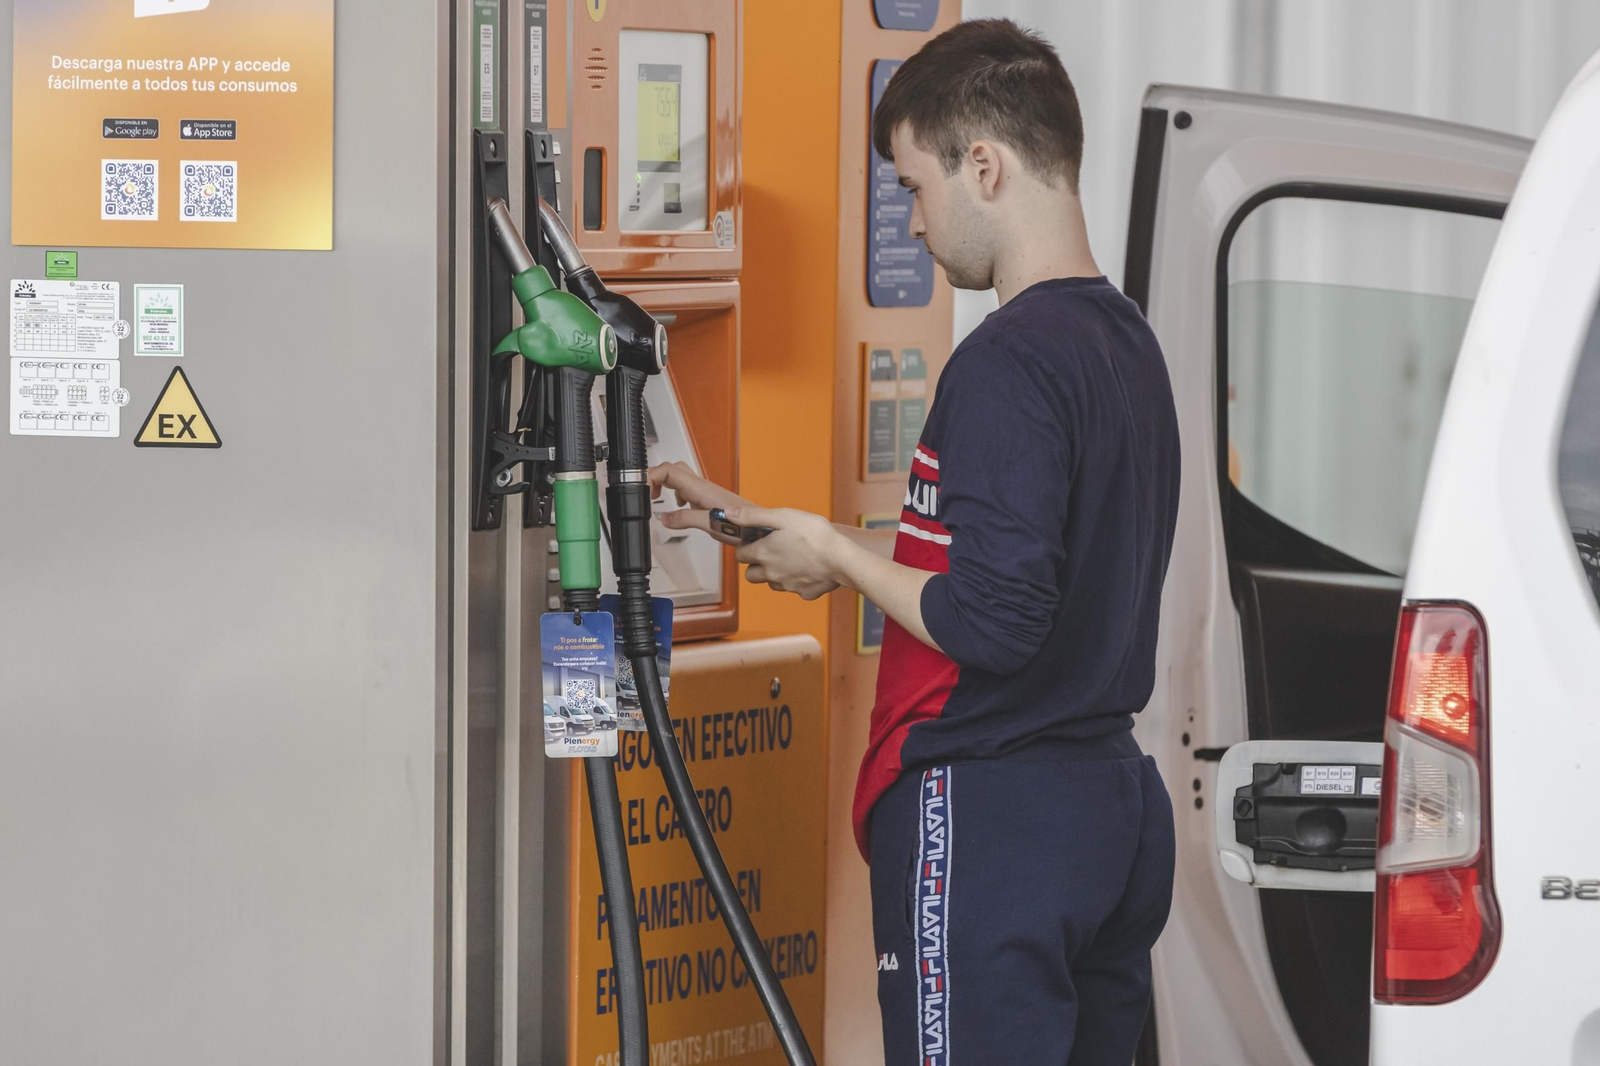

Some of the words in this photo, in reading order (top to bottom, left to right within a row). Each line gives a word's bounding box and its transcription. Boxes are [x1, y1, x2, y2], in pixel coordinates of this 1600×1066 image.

[51, 55, 122, 73] Descarga
[126, 58, 184, 71] nuestra
[187, 57, 218, 71] APP
[222, 60, 231, 74] y
[234, 57, 291, 72] accede
[47, 75, 128, 90] fácilmente
[132, 79, 140, 90] a
[145, 76, 188, 91] todos
[191, 78, 215, 91] tus
[219, 80, 298, 92] consumos
[115, 126, 141, 137] Google
[142, 127, 157, 137] play
[194, 128, 211, 138] App
[212, 128, 232, 137] Store
[158, 413, 197, 439] EX
[563, 737, 600, 746] Plenergy
[702, 704, 793, 761] EFECTIVO
[1316, 783, 1343, 791] DIESEL
[628, 798, 651, 846] EL
[877, 952, 899, 971] FILA
[697, 947, 726, 996] NO
[650, 1035, 702, 1066] YMENTS
[702, 1030, 720, 1062] AT
[723, 1026, 747, 1058] THE
[748, 1021, 774, 1050] ATM
